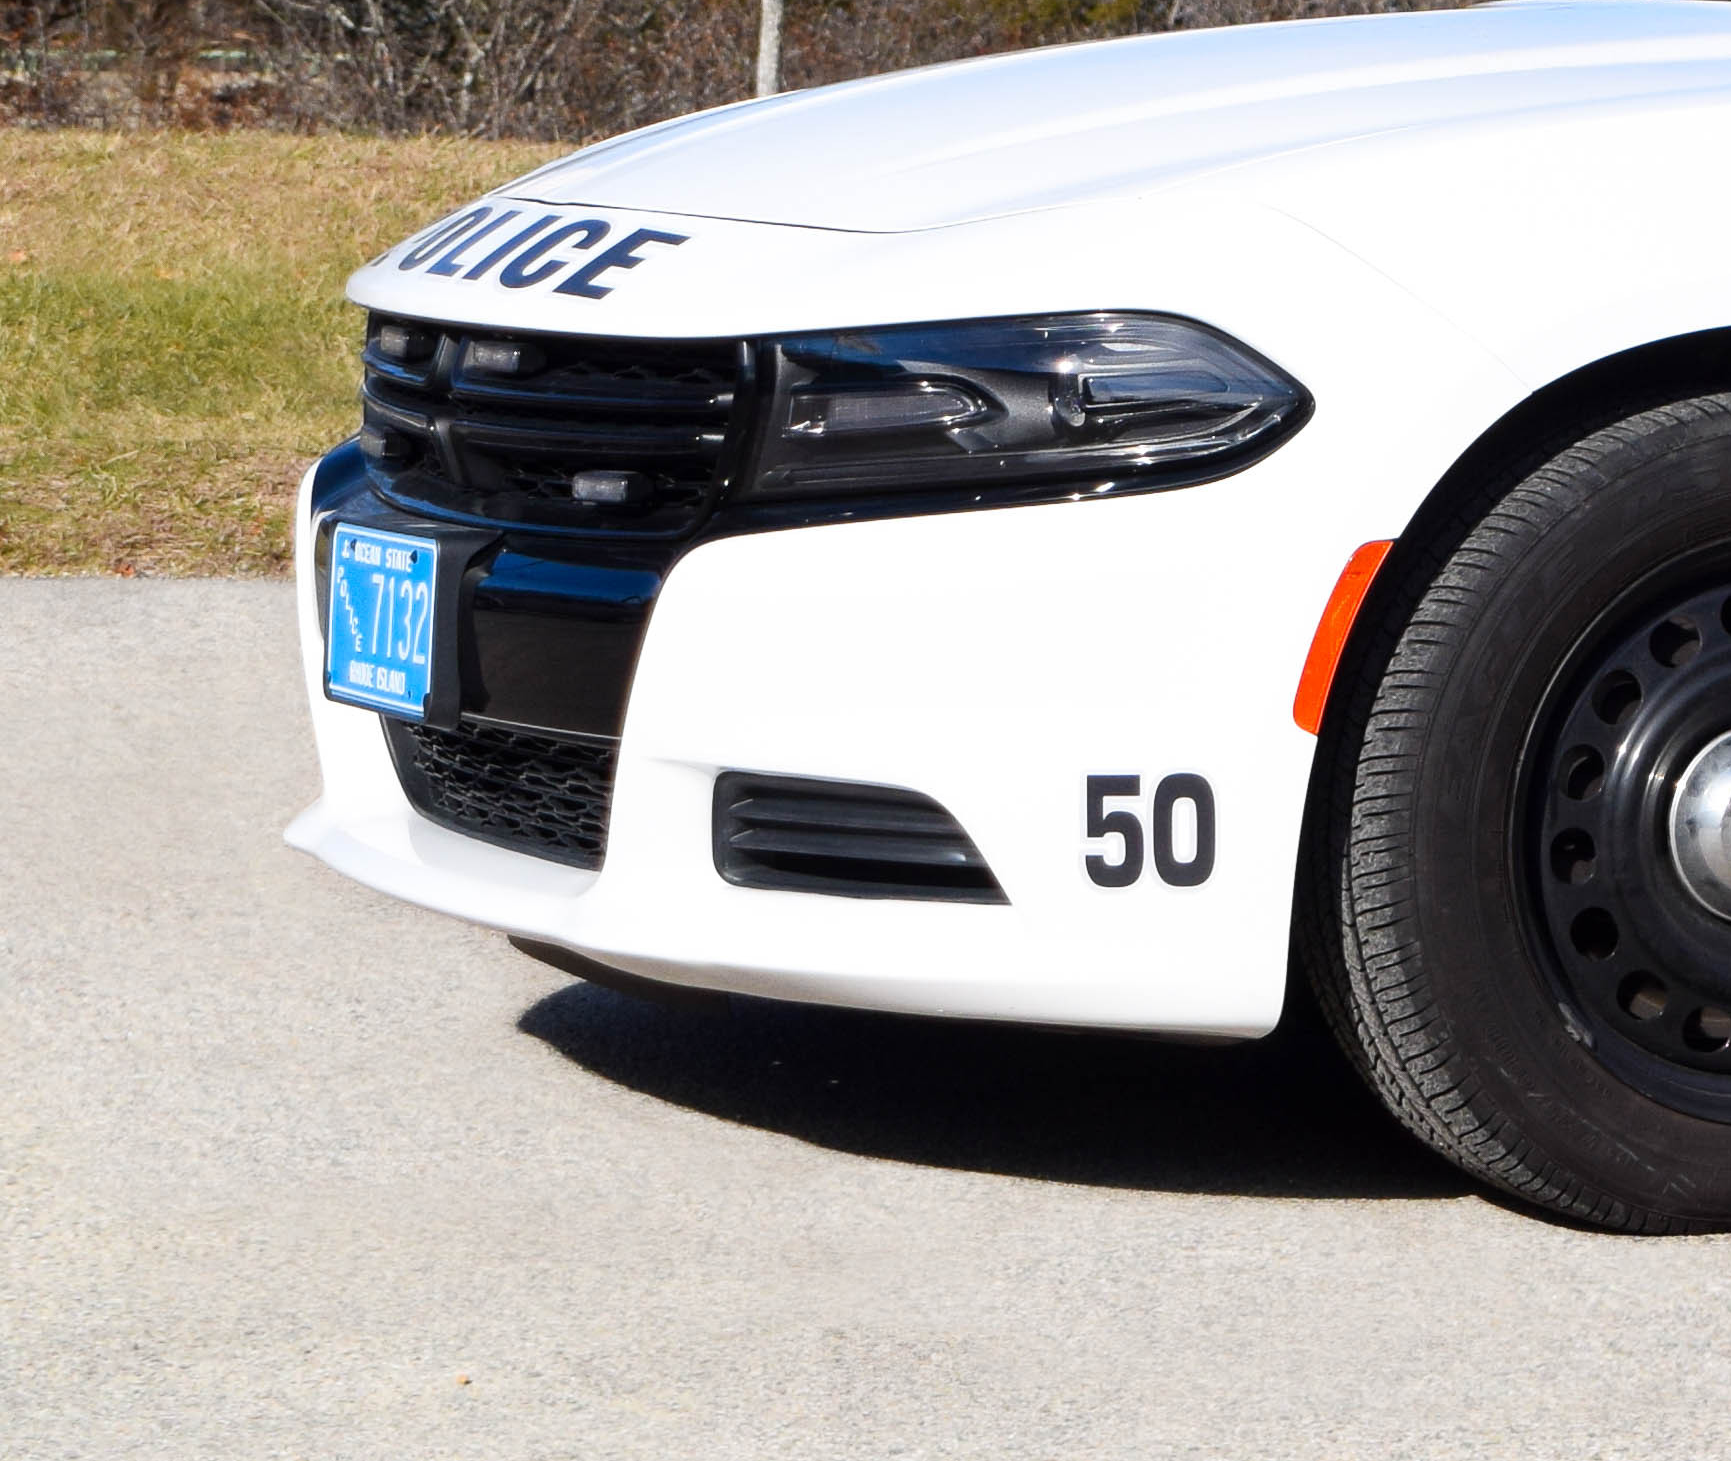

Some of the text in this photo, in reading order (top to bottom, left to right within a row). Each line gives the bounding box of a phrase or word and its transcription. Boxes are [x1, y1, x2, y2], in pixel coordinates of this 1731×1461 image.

[370, 206, 692, 300] OLICE
[354, 542, 412, 573] OCEAN STATE
[336, 566, 362, 653] POLICE
[371, 574, 428, 665] 7132
[349, 660, 407, 695] RHODE ISLAND
[1085, 773, 1216, 888] 50
